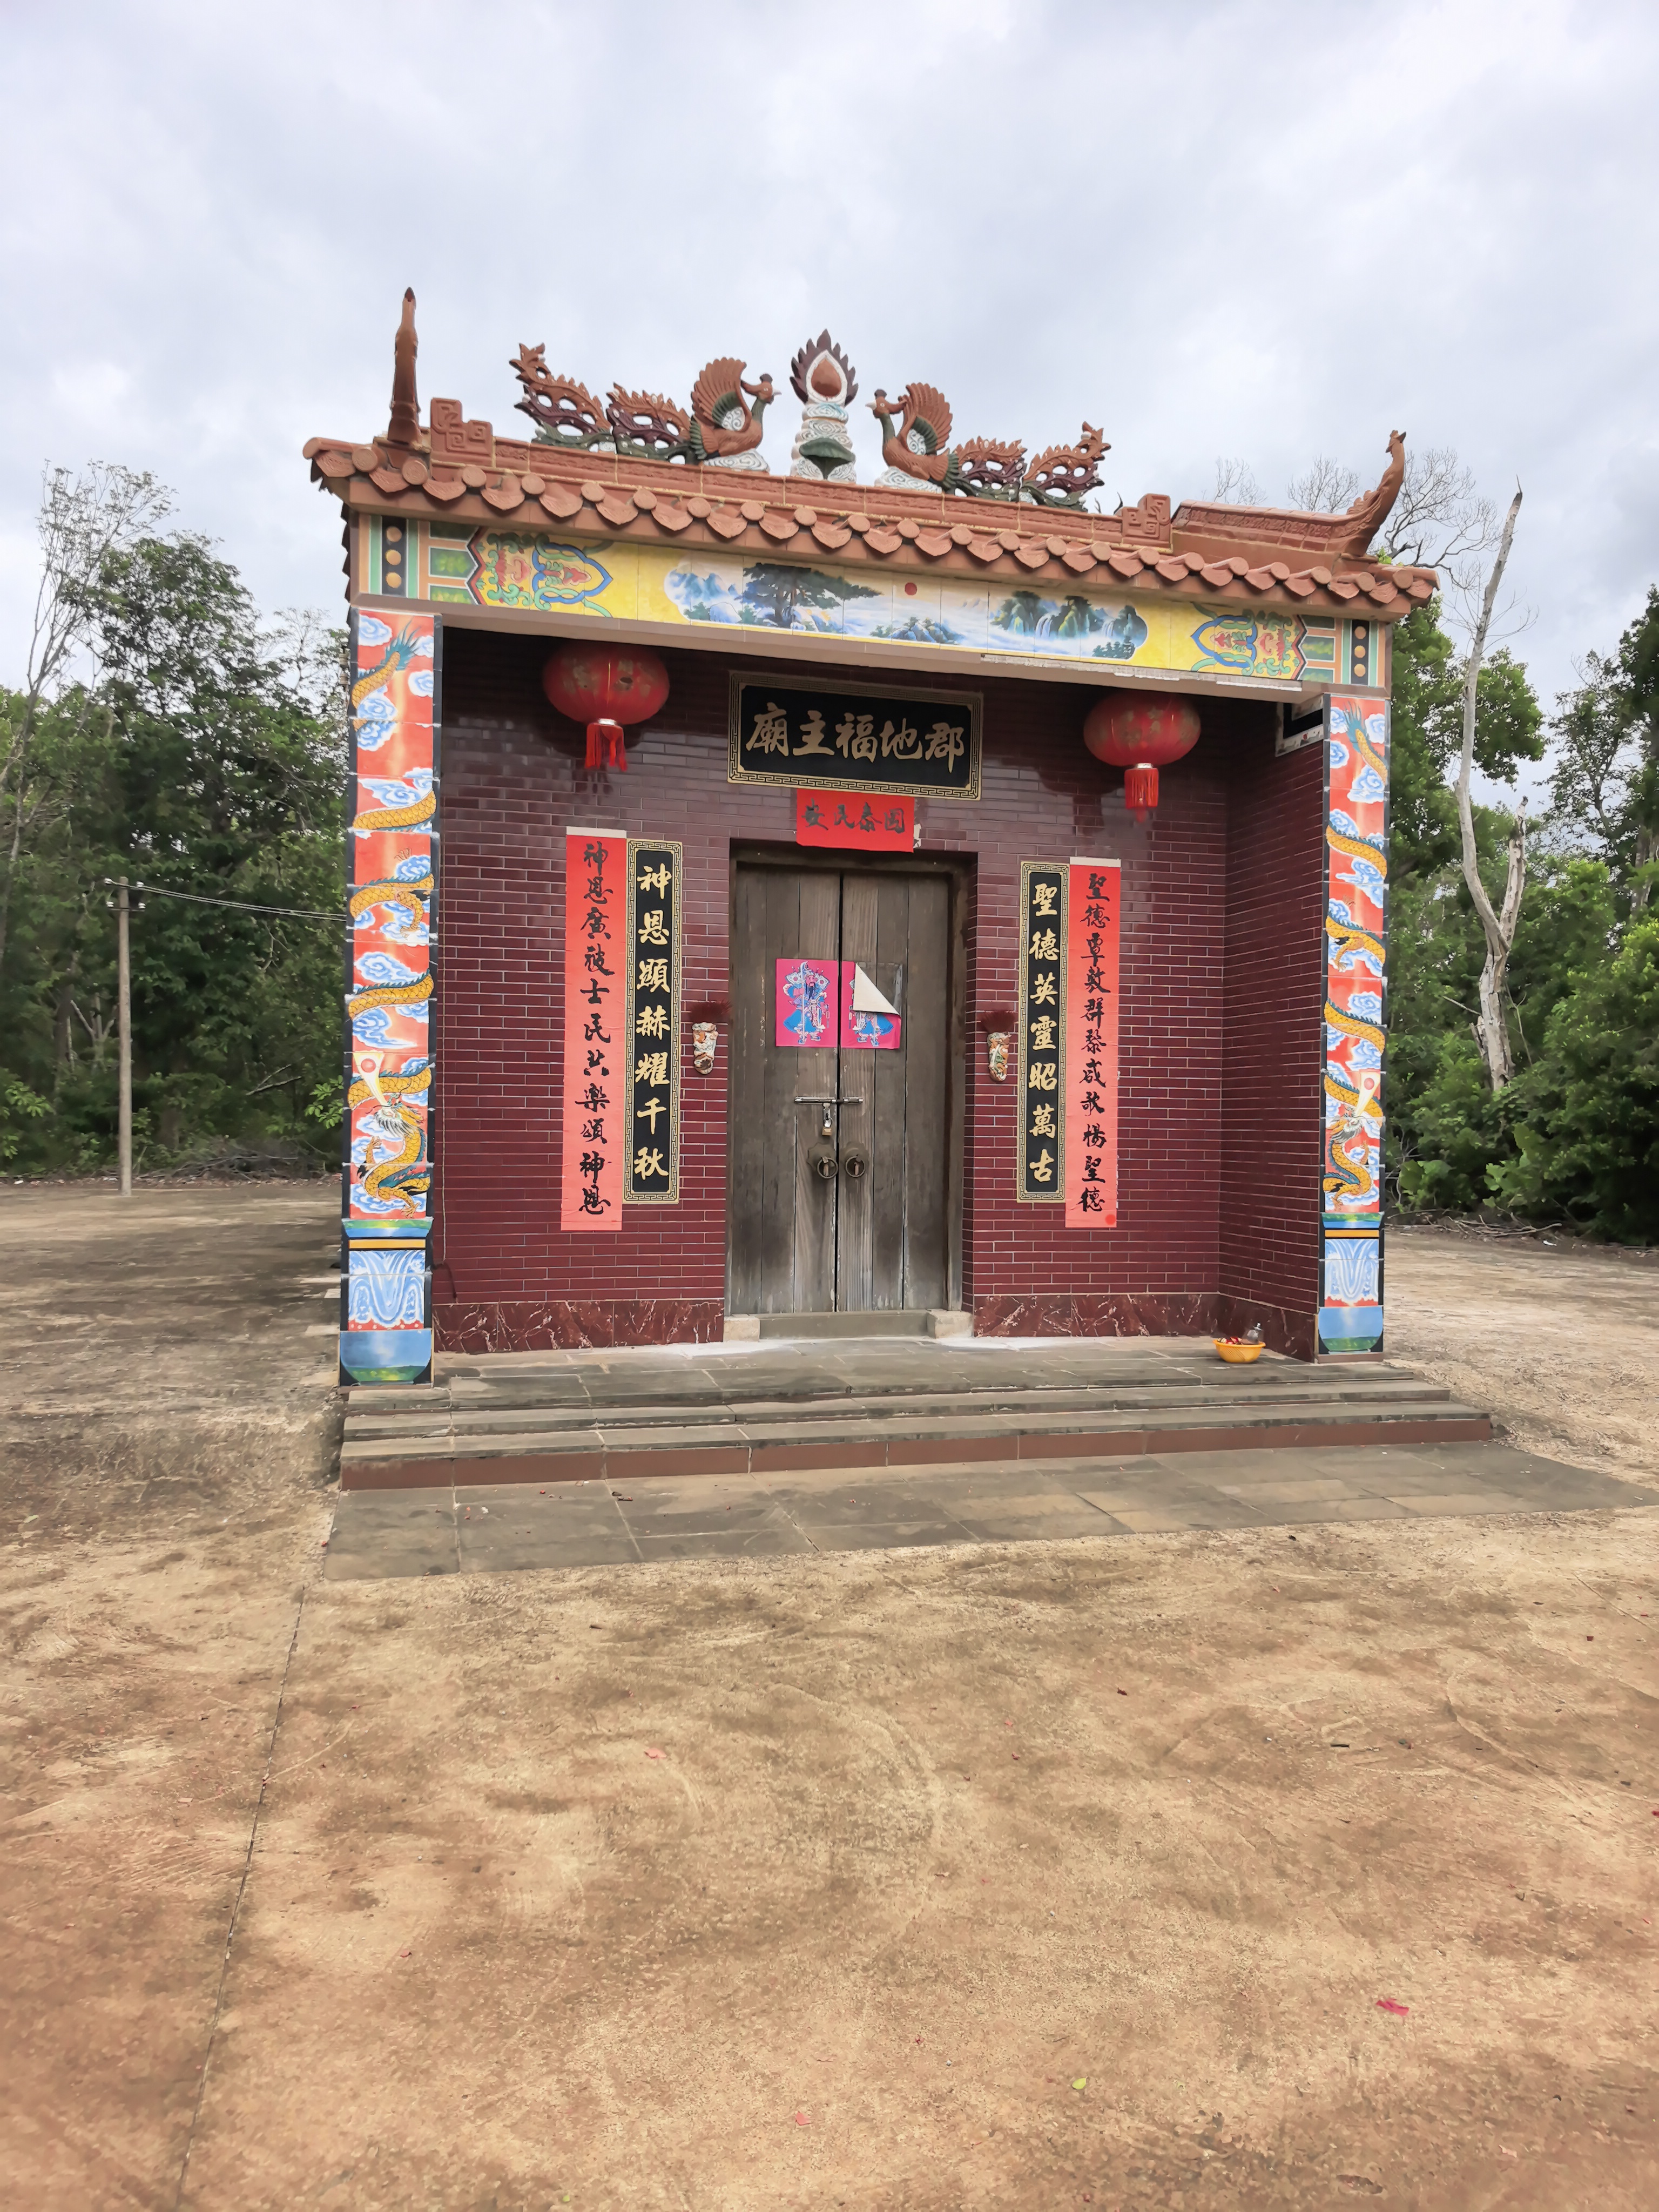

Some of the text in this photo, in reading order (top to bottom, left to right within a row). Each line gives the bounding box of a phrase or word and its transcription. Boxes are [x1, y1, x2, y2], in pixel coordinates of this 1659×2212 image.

[1029, 883, 1060, 1182] 聖德英靈昭萬古
